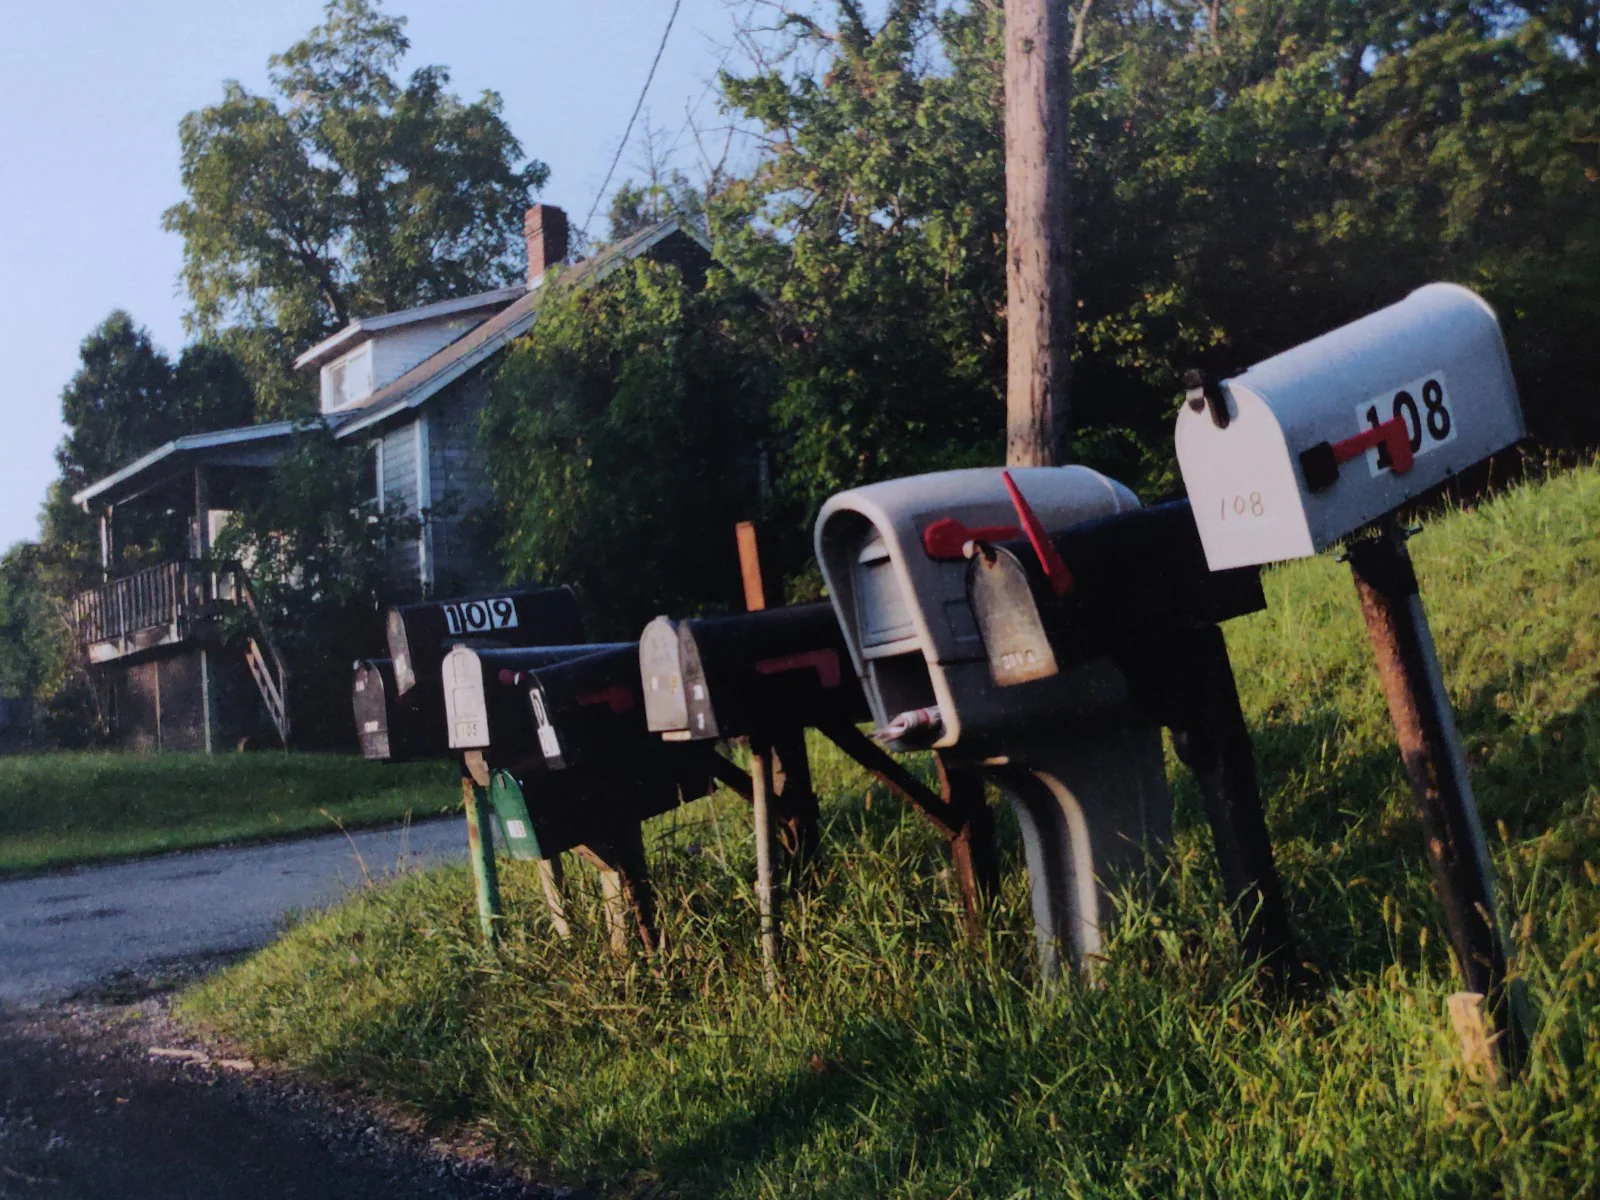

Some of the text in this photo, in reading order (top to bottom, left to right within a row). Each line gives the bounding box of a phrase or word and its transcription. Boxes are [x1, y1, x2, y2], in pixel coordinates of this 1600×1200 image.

[1366, 379, 1450, 470] 108
[1221, 490, 1264, 521] 108
[445, 599, 515, 633] 109
